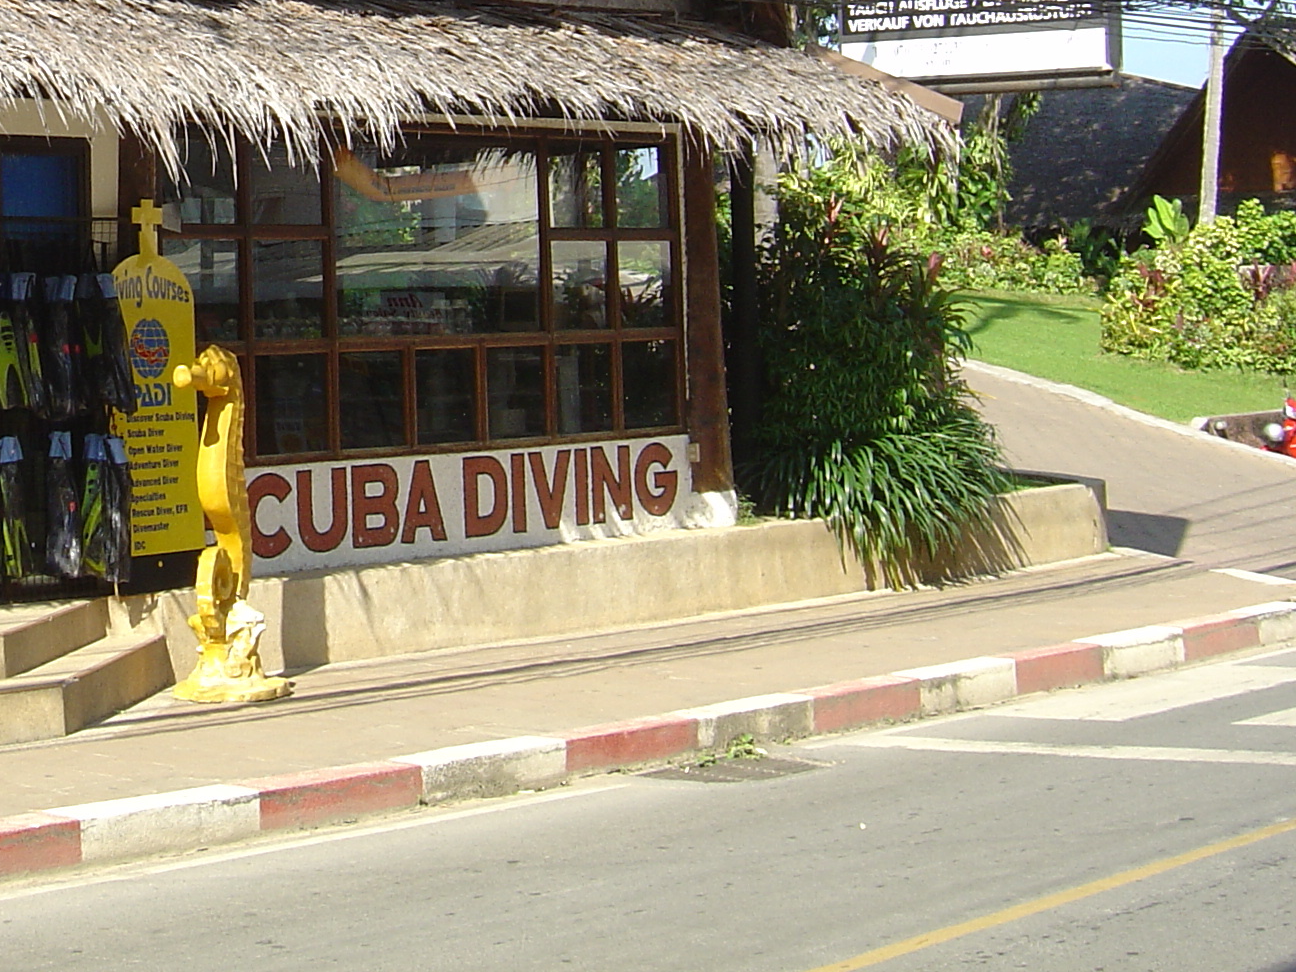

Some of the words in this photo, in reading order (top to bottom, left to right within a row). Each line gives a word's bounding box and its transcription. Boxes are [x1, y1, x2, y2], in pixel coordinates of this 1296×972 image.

[847, 16, 911, 33] VERKAUF
[912, 14, 945, 29] VON
[115, 269, 143, 308] iving
[145, 265, 190, 303] Courses
[133, 382, 172, 407] PADI
[155, 412, 174, 422] Scuba
[175, 411, 195, 422] Diving
[127, 429, 146, 438] Scuba
[147, 427, 165, 437] Diver
[128, 445, 145, 457] Open
[146, 444, 165, 454] Water
[166, 443, 183, 452] Diver
[163, 459, 179, 468] Diver
[163, 476, 179, 485] Diver
[245, 459, 448, 560] CUBA
[461, 441, 679, 539] DIVING
[131, 508, 154, 518] Rescue
[133, 522, 169, 534] Divemaster
[133, 540, 146, 551] IDC
